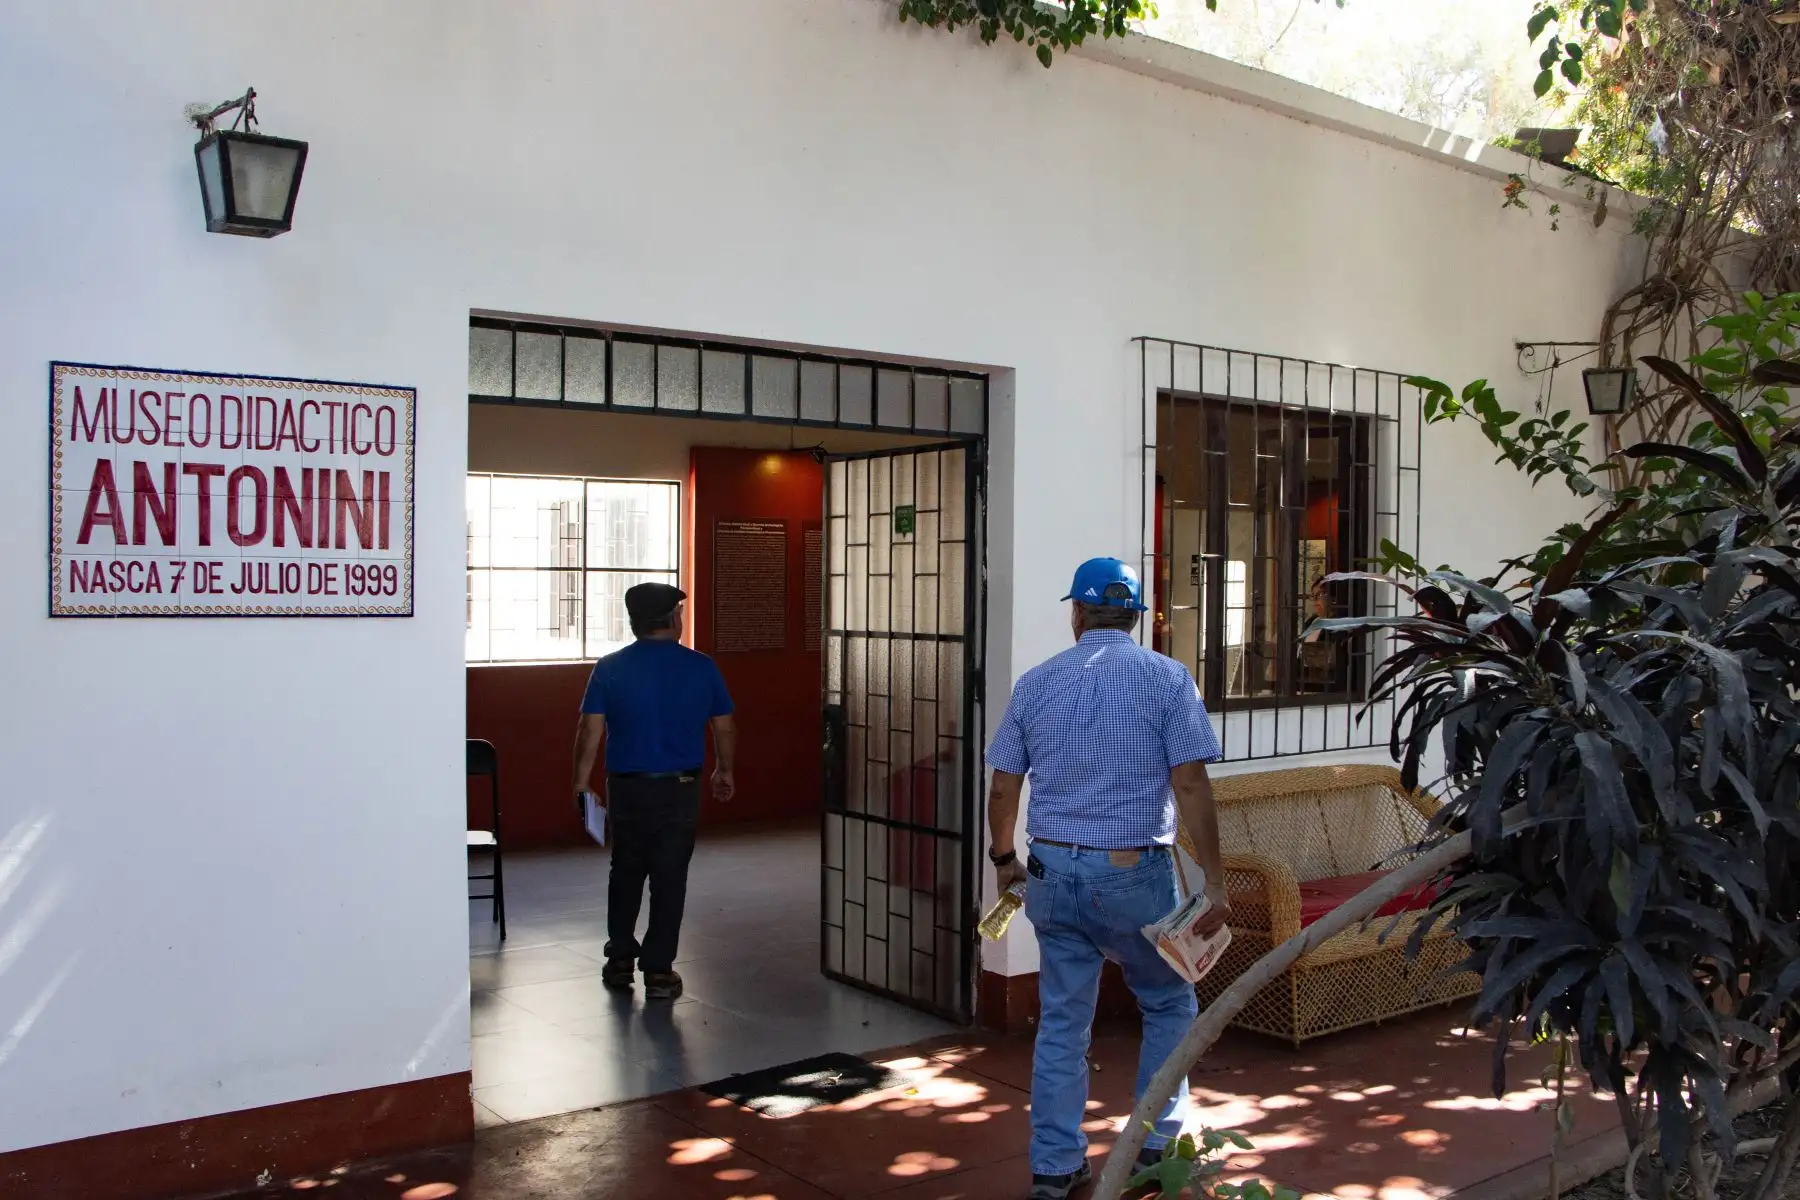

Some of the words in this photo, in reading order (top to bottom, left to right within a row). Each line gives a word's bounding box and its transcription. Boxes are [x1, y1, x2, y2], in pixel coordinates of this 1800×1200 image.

[70, 385, 211, 448] MUSEO
[220, 394, 396, 456] DIDACTICO
[76, 458, 391, 550] ANTONINI
[70, 559, 162, 594] NASCA
[169, 561, 187, 594] 7
[193, 561, 224, 594] DE
[230, 561, 301, 595] JULIO
[307, 562, 339, 596] DE
[344, 563, 398, 597] 1999
